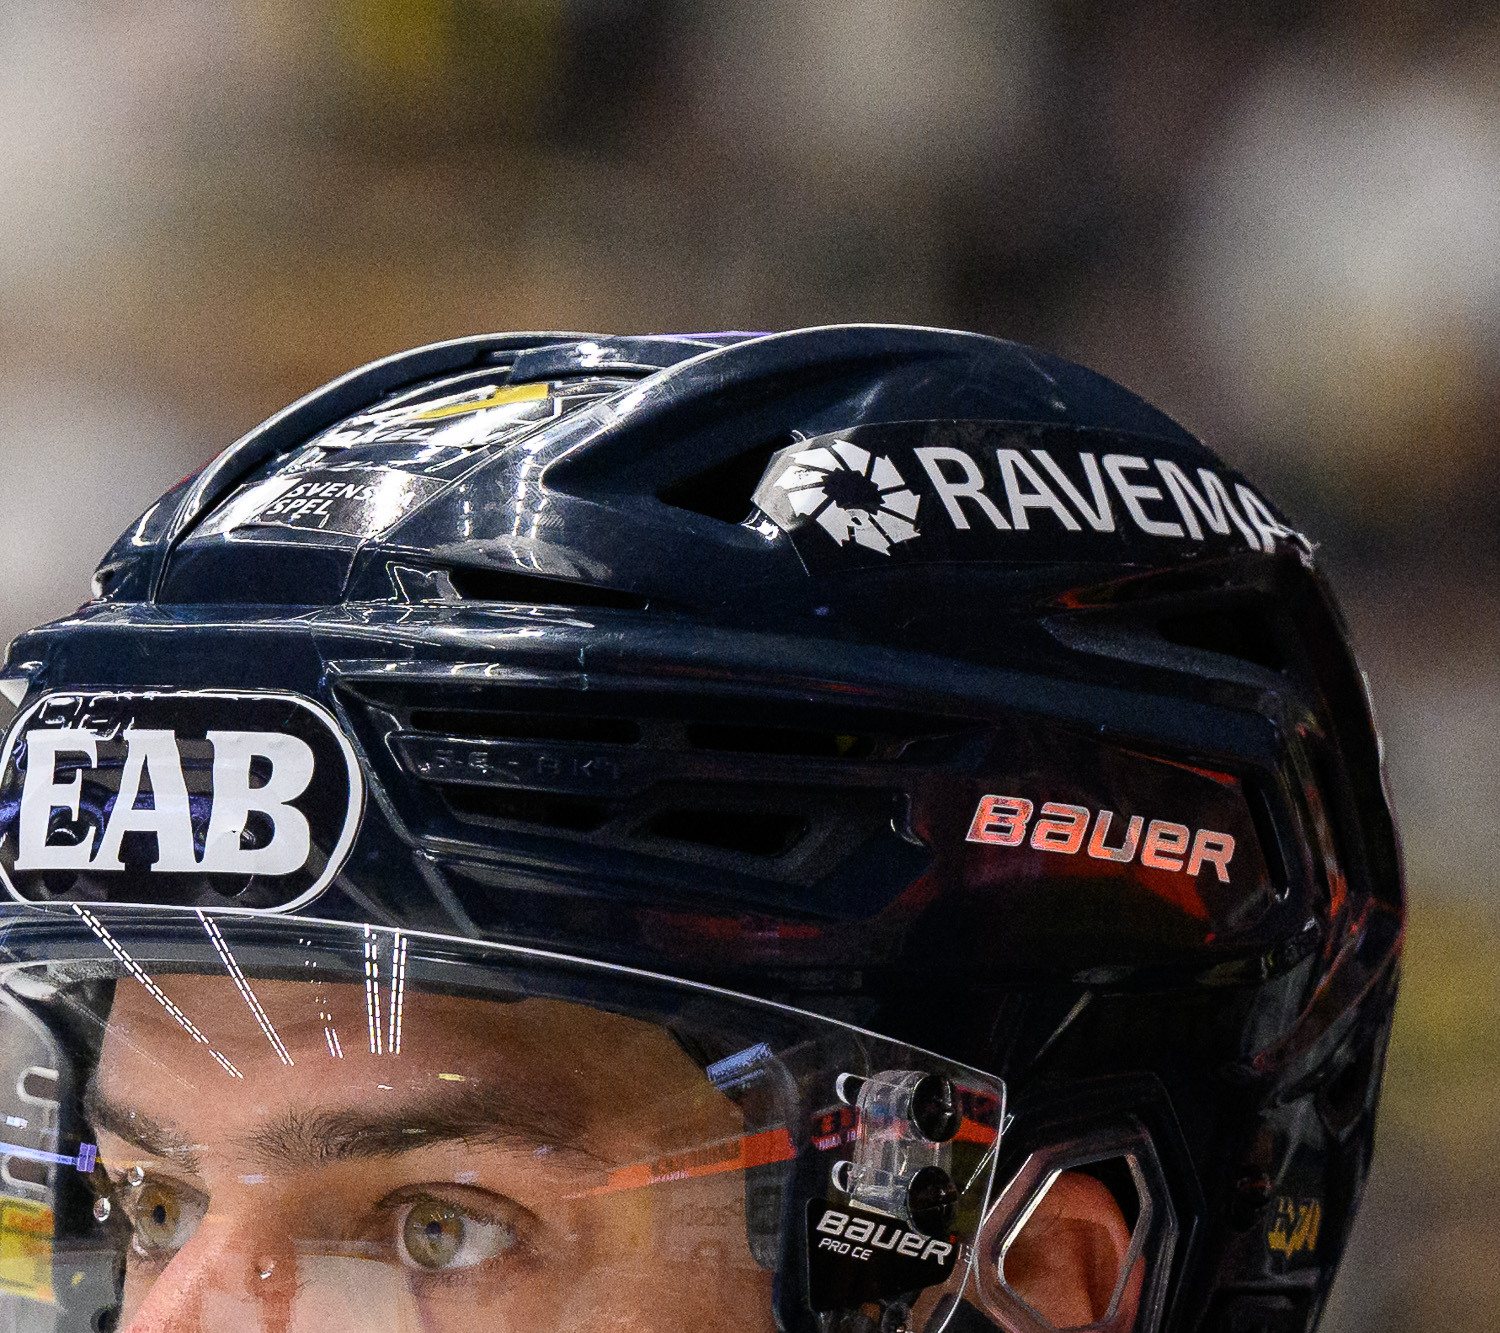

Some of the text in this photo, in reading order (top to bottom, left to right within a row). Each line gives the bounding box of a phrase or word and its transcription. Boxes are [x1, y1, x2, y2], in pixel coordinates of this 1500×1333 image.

[266, 498, 334, 516] SPEL
[13, 728, 315, 876] EAB
[817, 1237, 874, 1262] PRO CE
